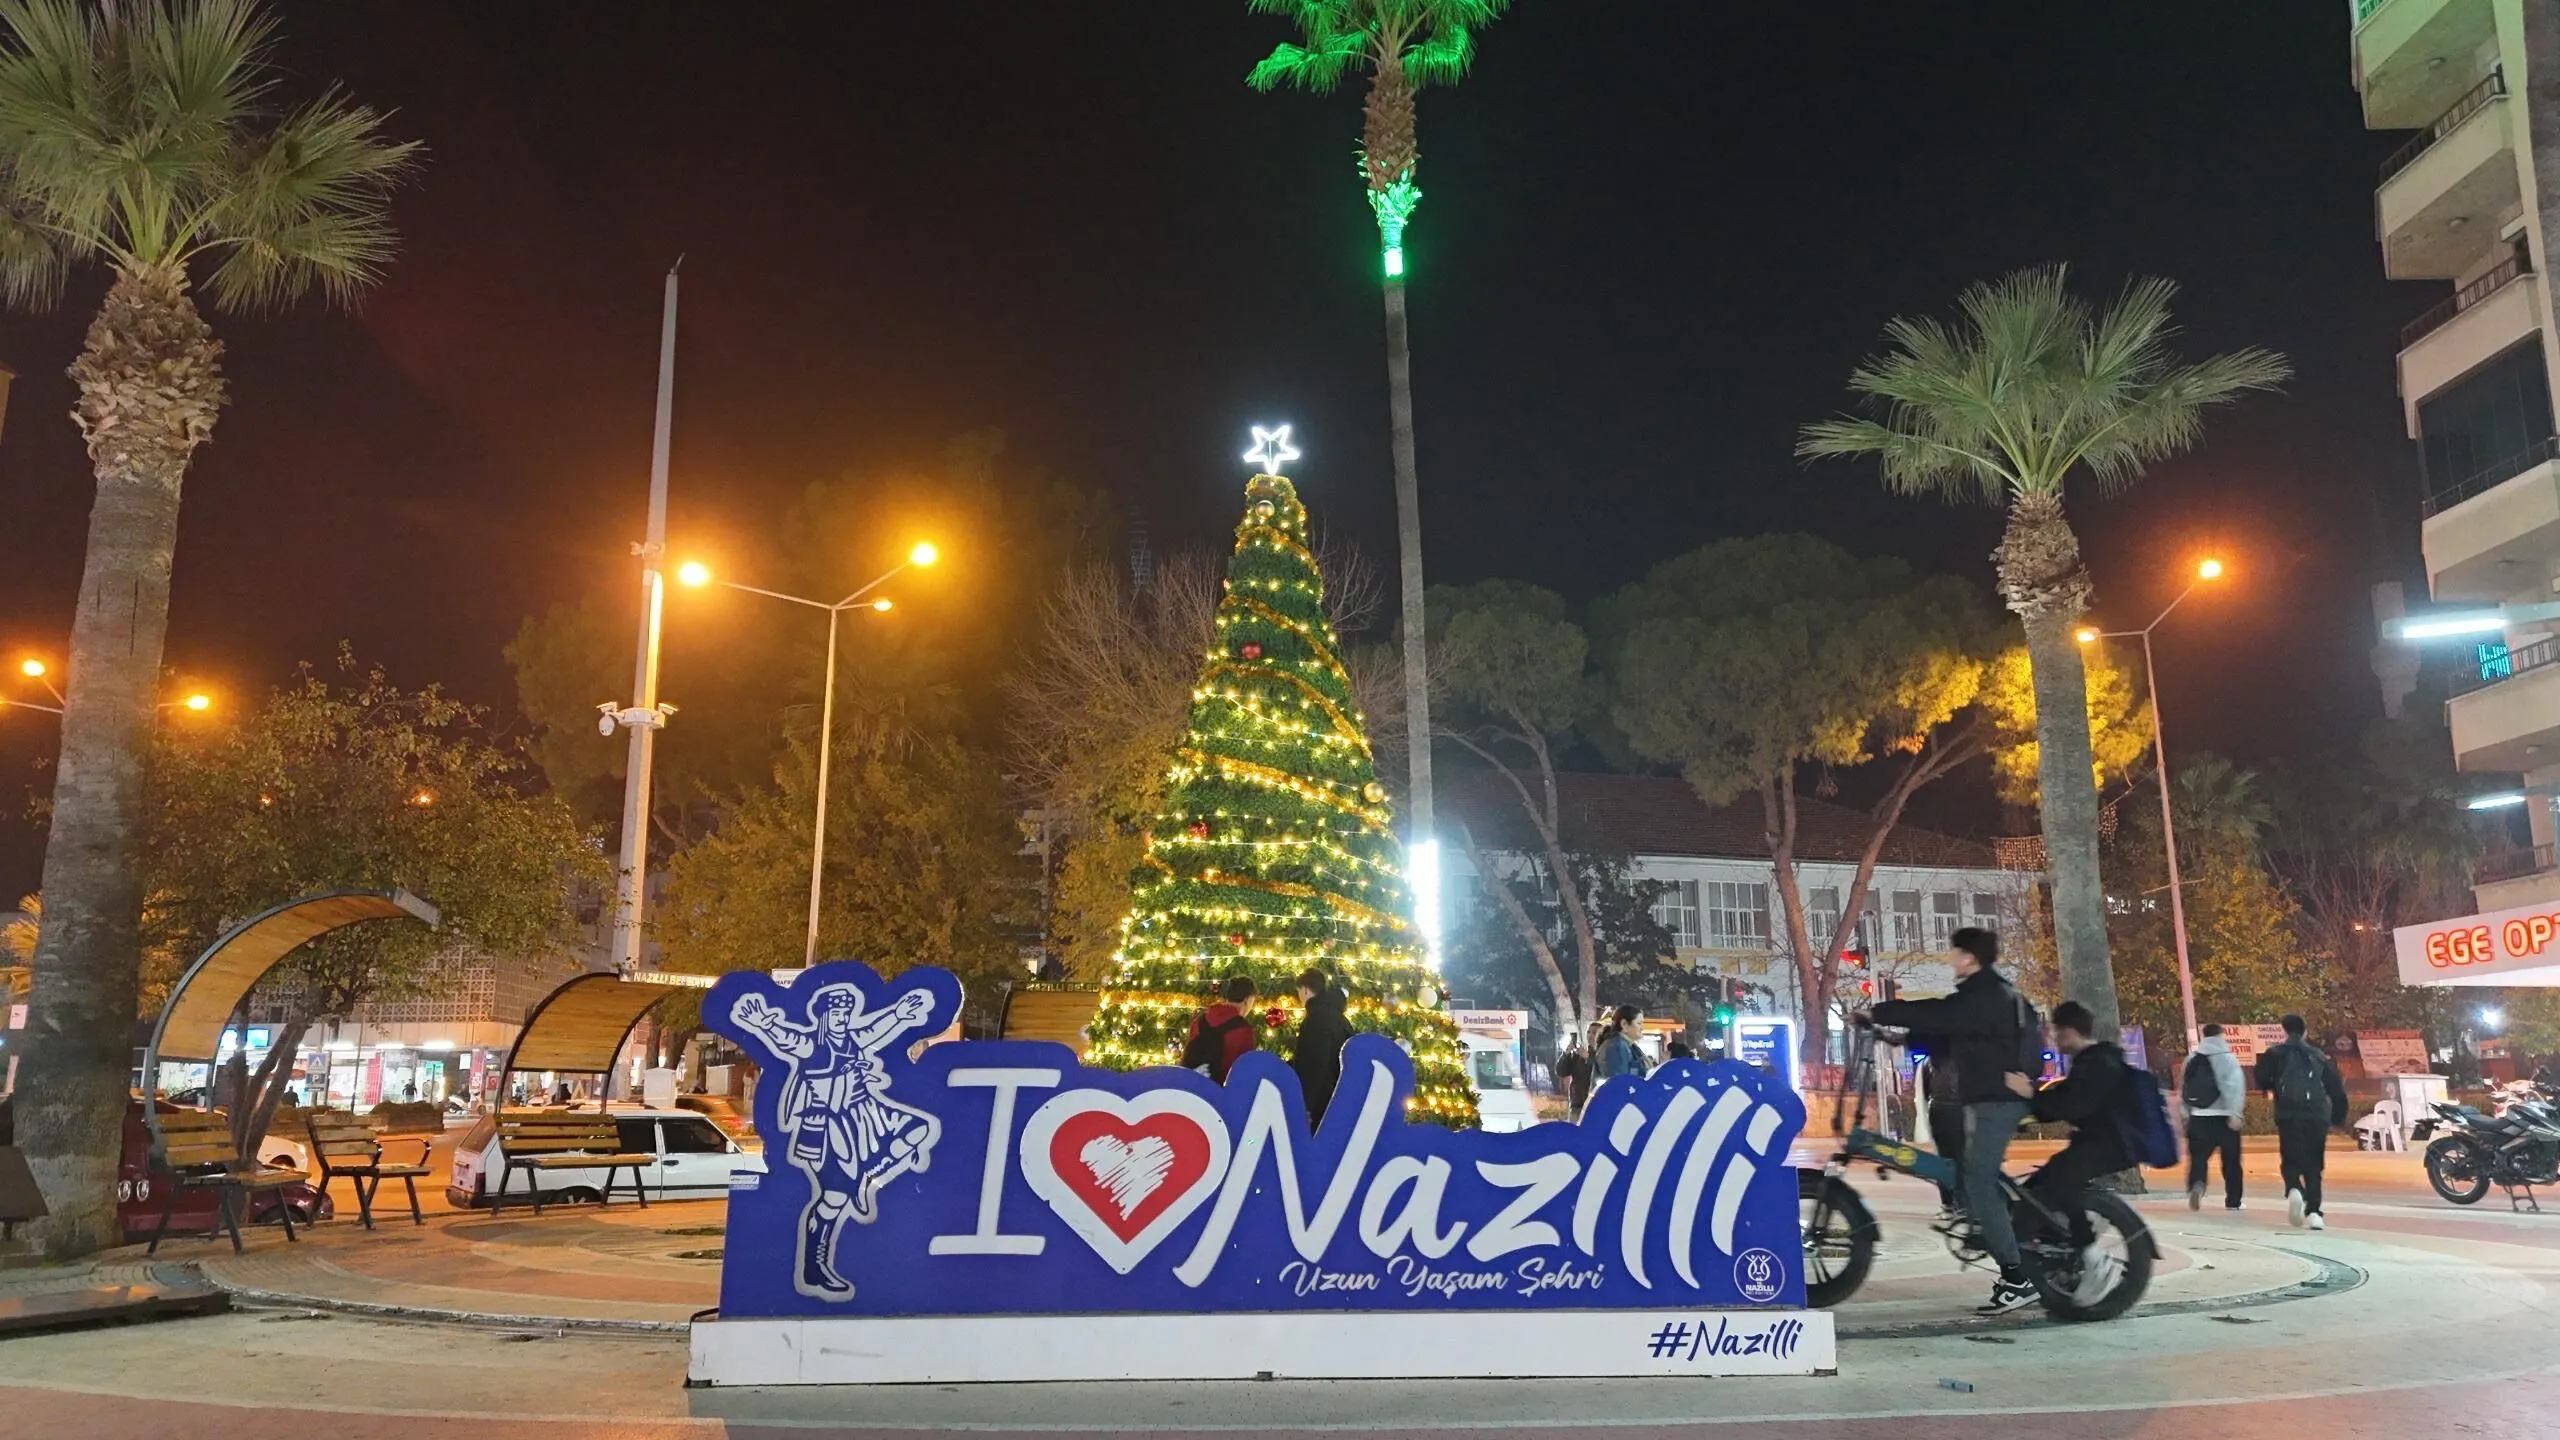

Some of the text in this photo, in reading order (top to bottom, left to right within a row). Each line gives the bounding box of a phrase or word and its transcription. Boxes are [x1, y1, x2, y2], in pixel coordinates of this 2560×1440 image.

[2426, 926, 2493, 968] EGE
[1463, 1016, 1504, 1025] DenizBank
[929, 1059, 1783, 1290] I Nazilli
[1279, 1256, 1604, 1299] Uzun Yaşam Şehri
[1647, 1316, 1803, 1361] #Nazilli
